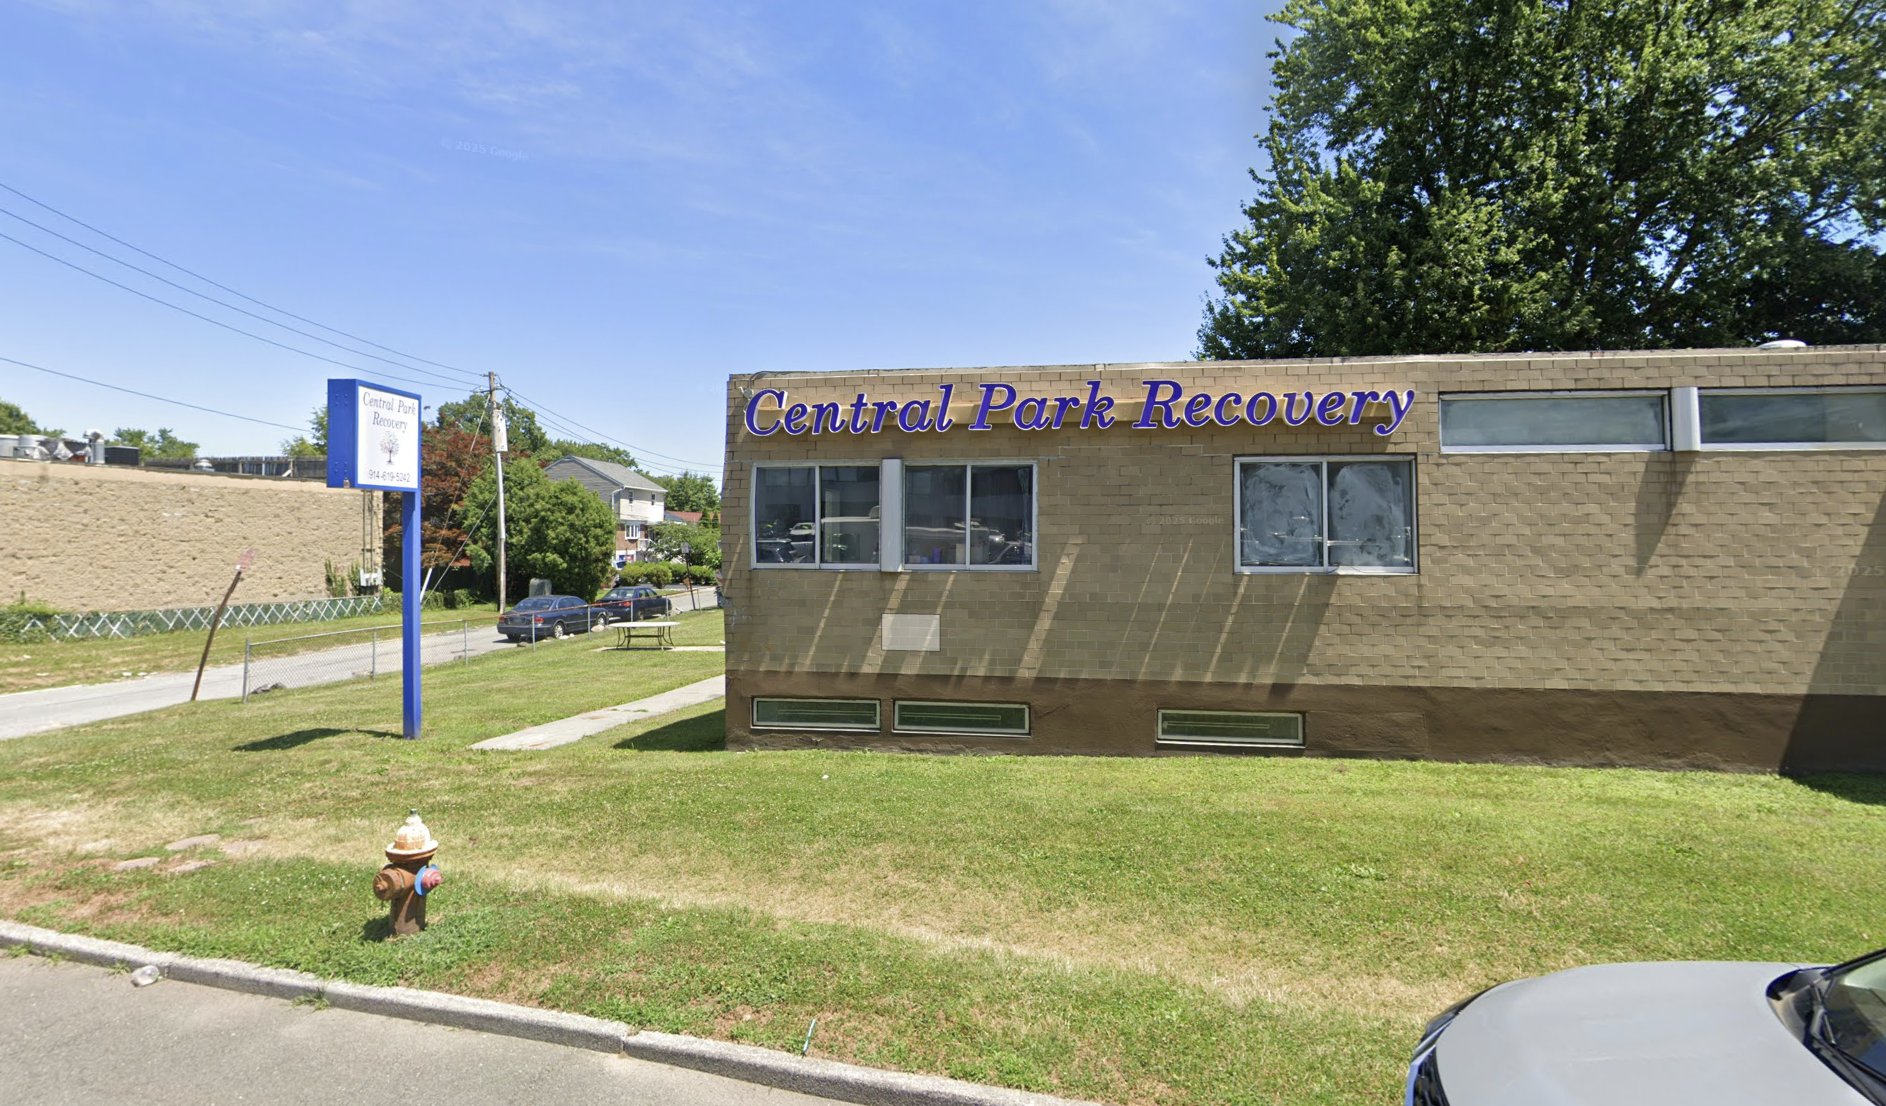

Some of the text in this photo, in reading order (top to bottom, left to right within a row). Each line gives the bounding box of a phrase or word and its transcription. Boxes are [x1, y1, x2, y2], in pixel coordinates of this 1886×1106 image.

[363, 392, 416, 415] Central Park
[745, 379, 1415, 436] Central Park Recovery
[373, 411, 408, 433] Recovery
[369, 469, 411, 482] 914-619-5242
